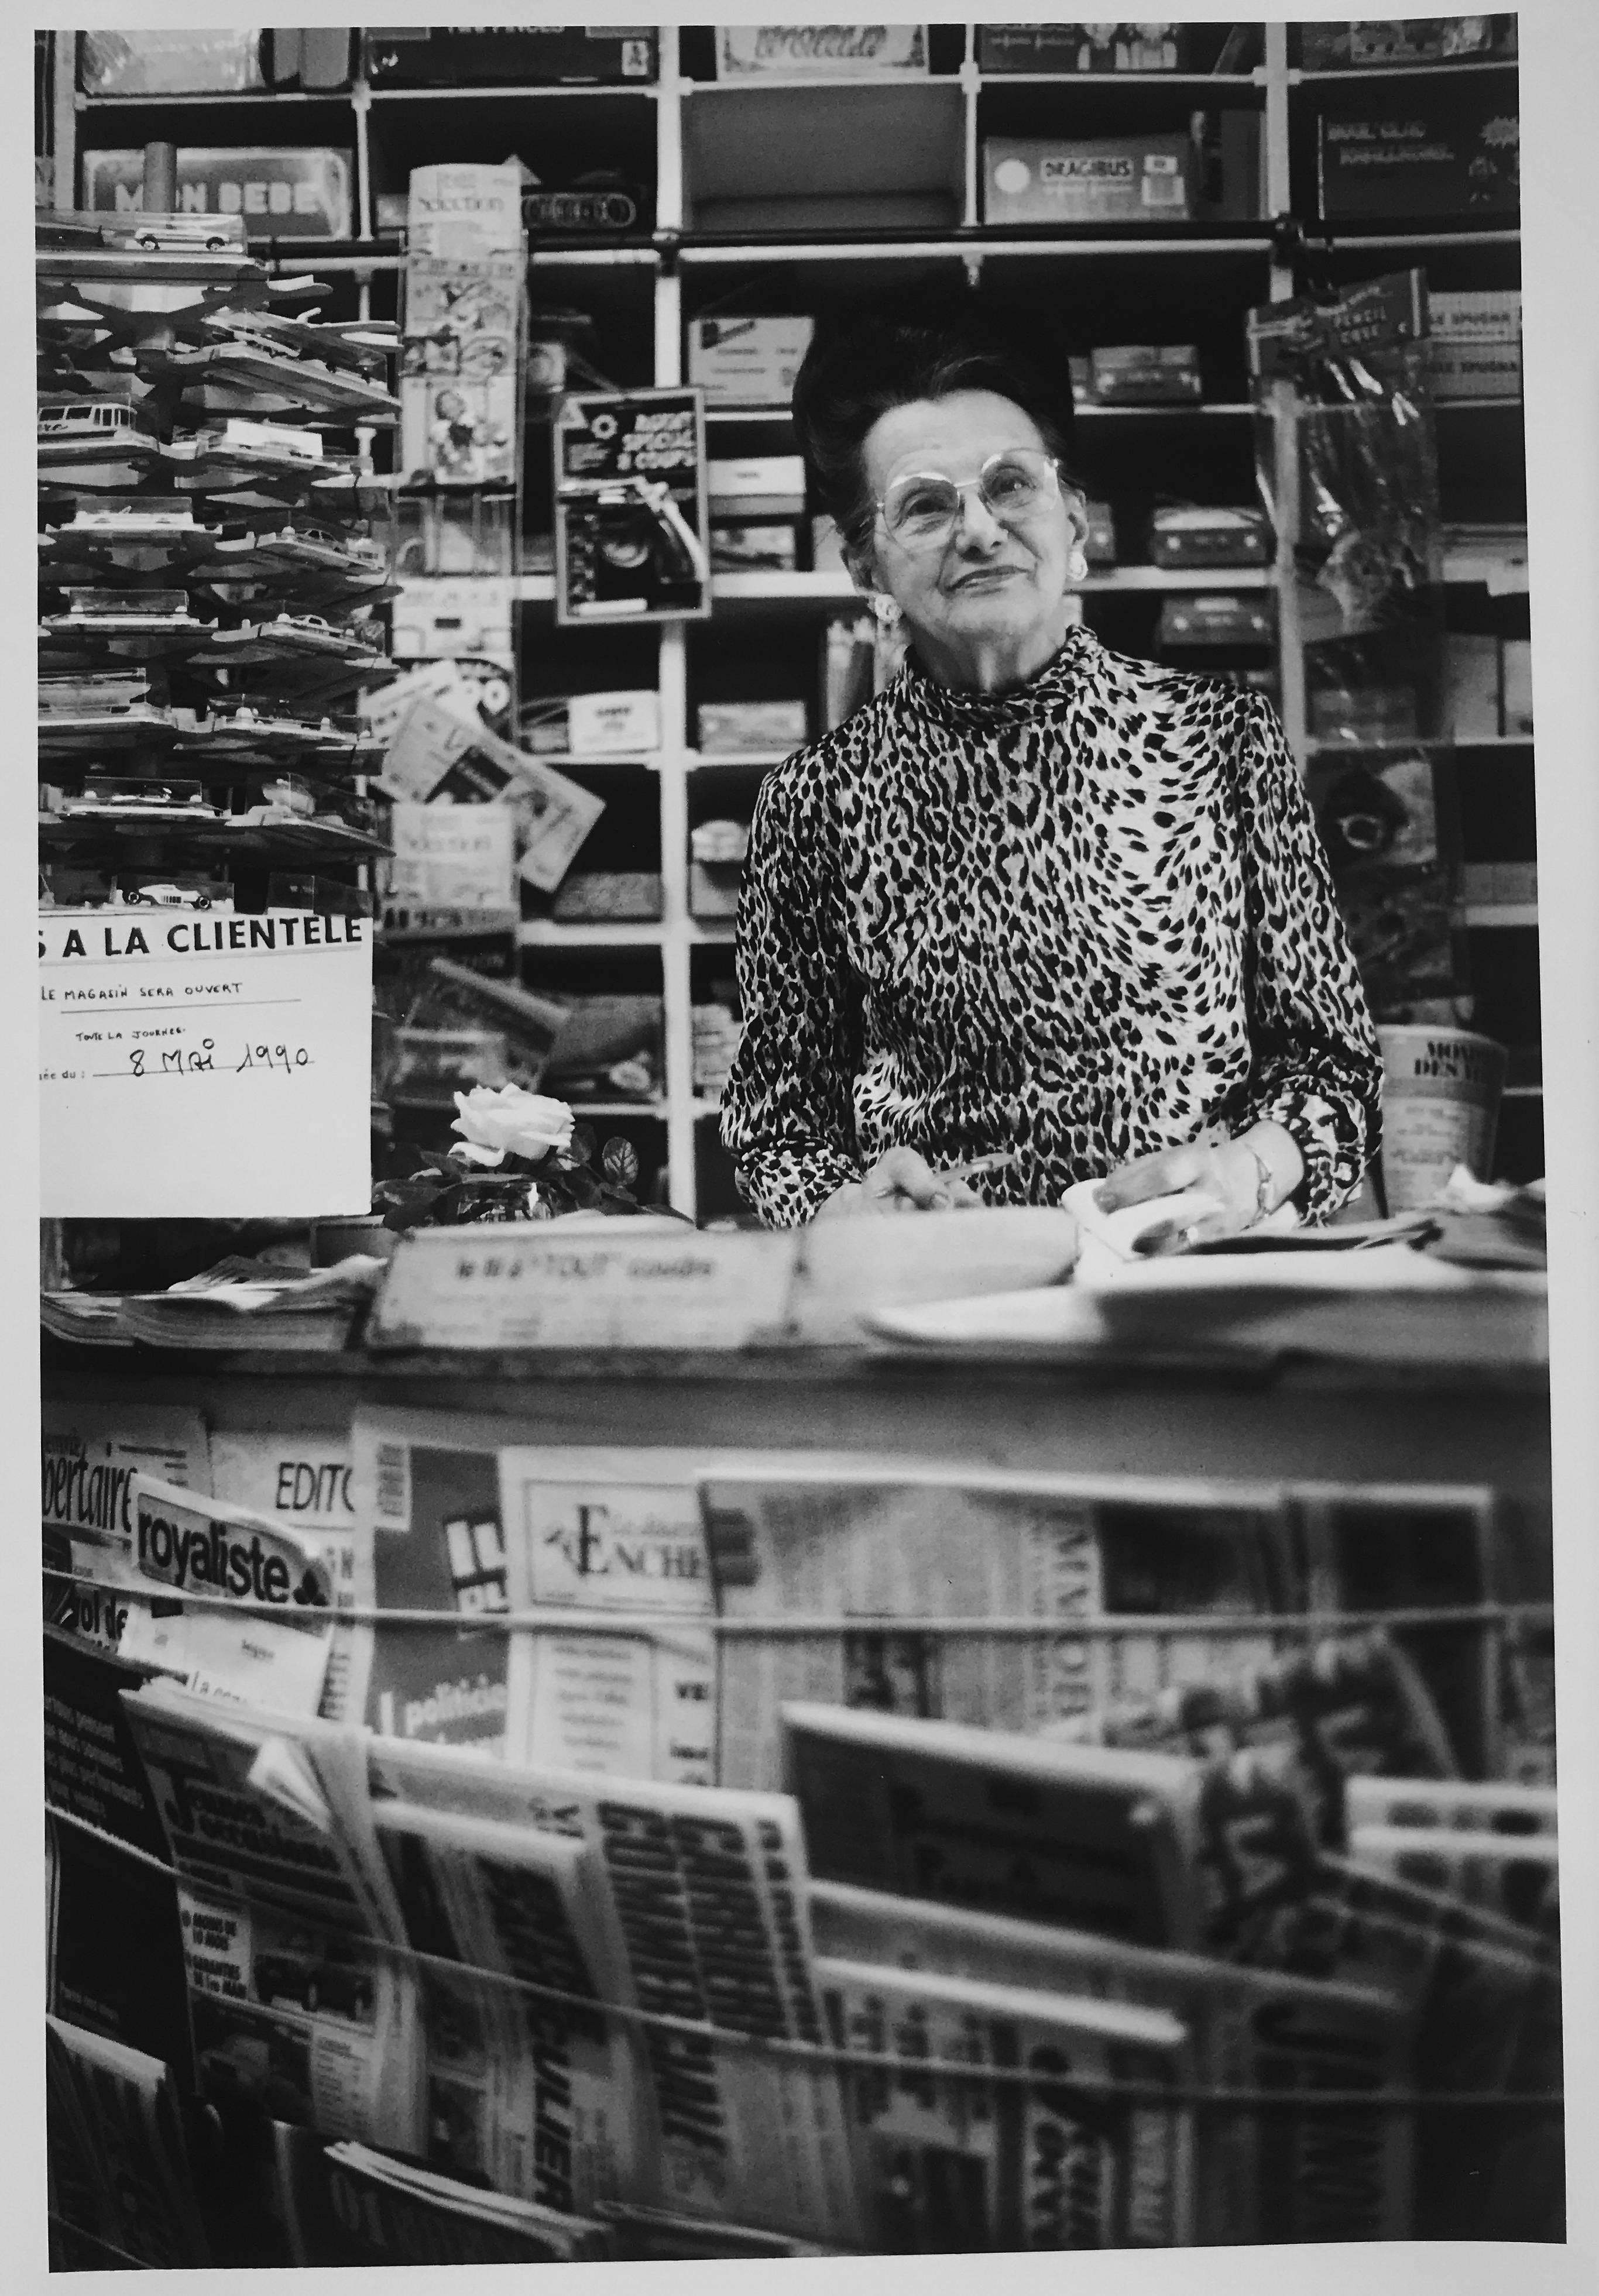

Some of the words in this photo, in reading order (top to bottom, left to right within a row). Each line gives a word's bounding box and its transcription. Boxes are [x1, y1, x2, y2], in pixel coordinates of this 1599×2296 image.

[115, 183, 207, 212] MN
[62, 929, 87, 957] A
[105, 926, 150, 957] LA
[167, 916, 362, 953] CLIENTELE
[41, 985, 56, 1000] LE
[64, 984, 128, 1000] MAGASIN
[140, 987, 174, 997] SERA
[185, 982, 243, 995] OUVERT
[76, 1032, 103, 1042] TOUTE
[108, 1031, 122, 1039] LA
[62, 1070, 76, 1079] du
[129, 1049, 145, 1077] 8
[236, 1043, 309, 1074] 1990
[138, 1512, 290, 1604] royaliste
